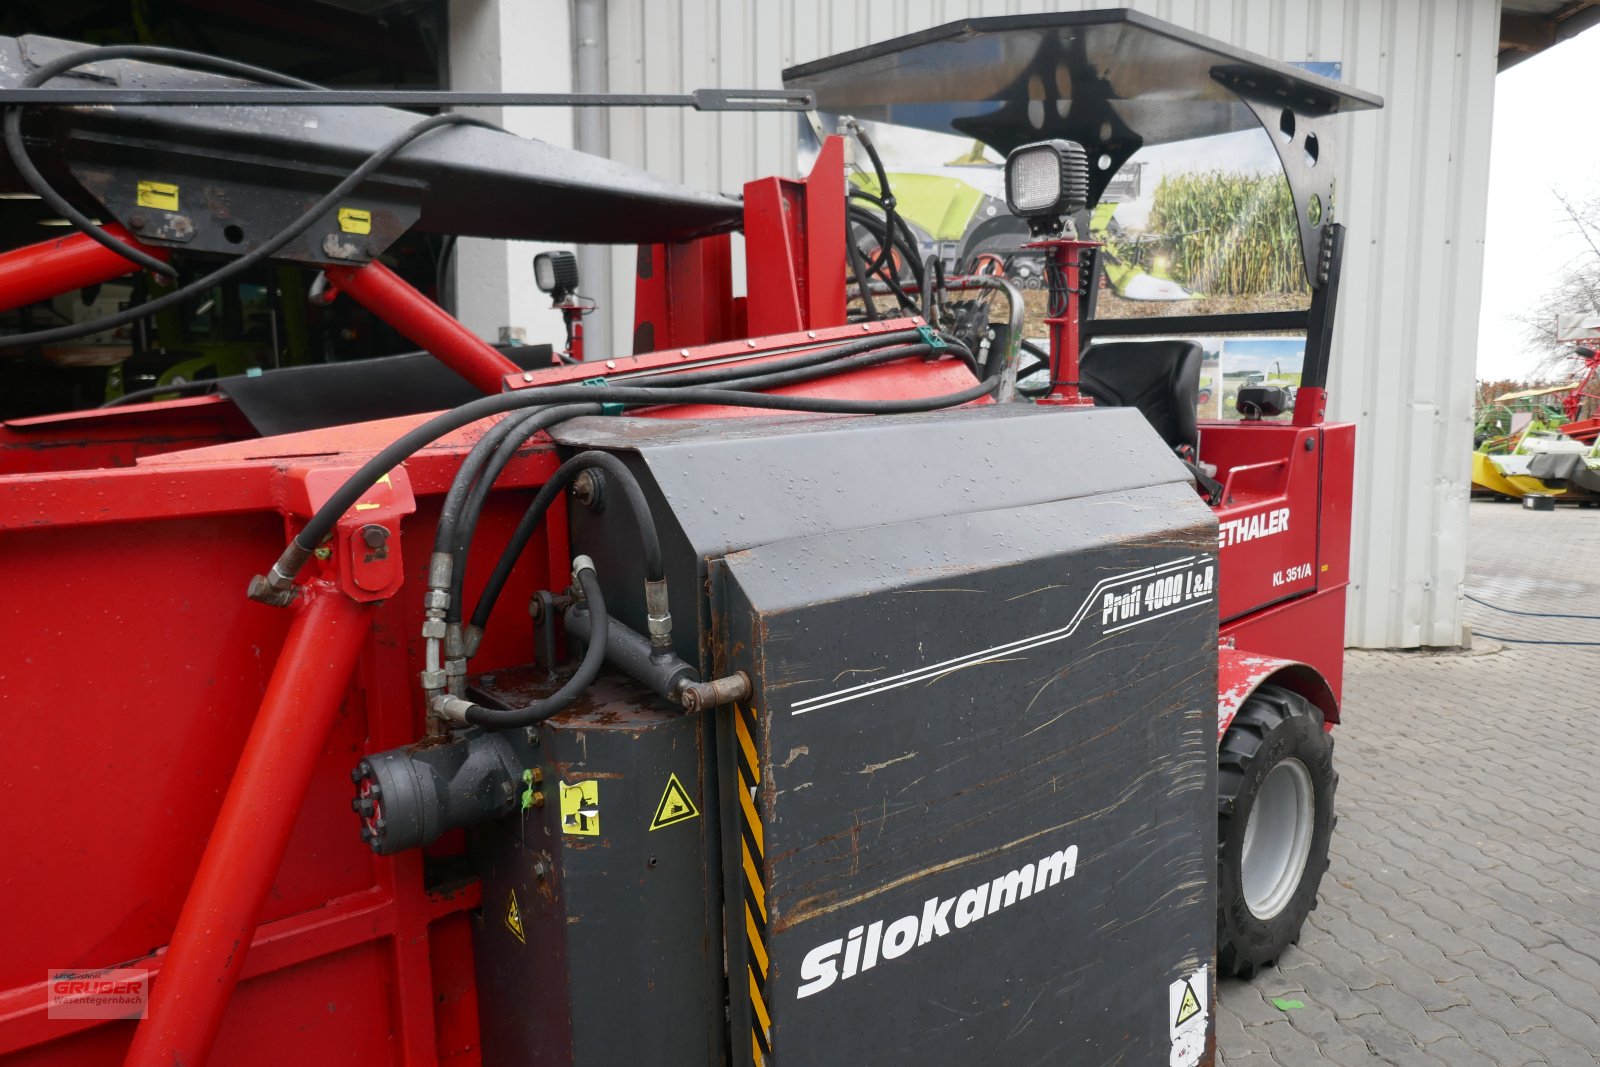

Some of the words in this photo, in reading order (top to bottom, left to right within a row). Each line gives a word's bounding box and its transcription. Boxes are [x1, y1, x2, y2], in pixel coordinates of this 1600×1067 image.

[1102, 584, 1142, 626] Profi
[1144, 573, 1183, 612] 4000
[1272, 571, 1285, 587] KL
[1286, 563, 1312, 583] 351/A
[796, 844, 1079, 1000] Silokamm
